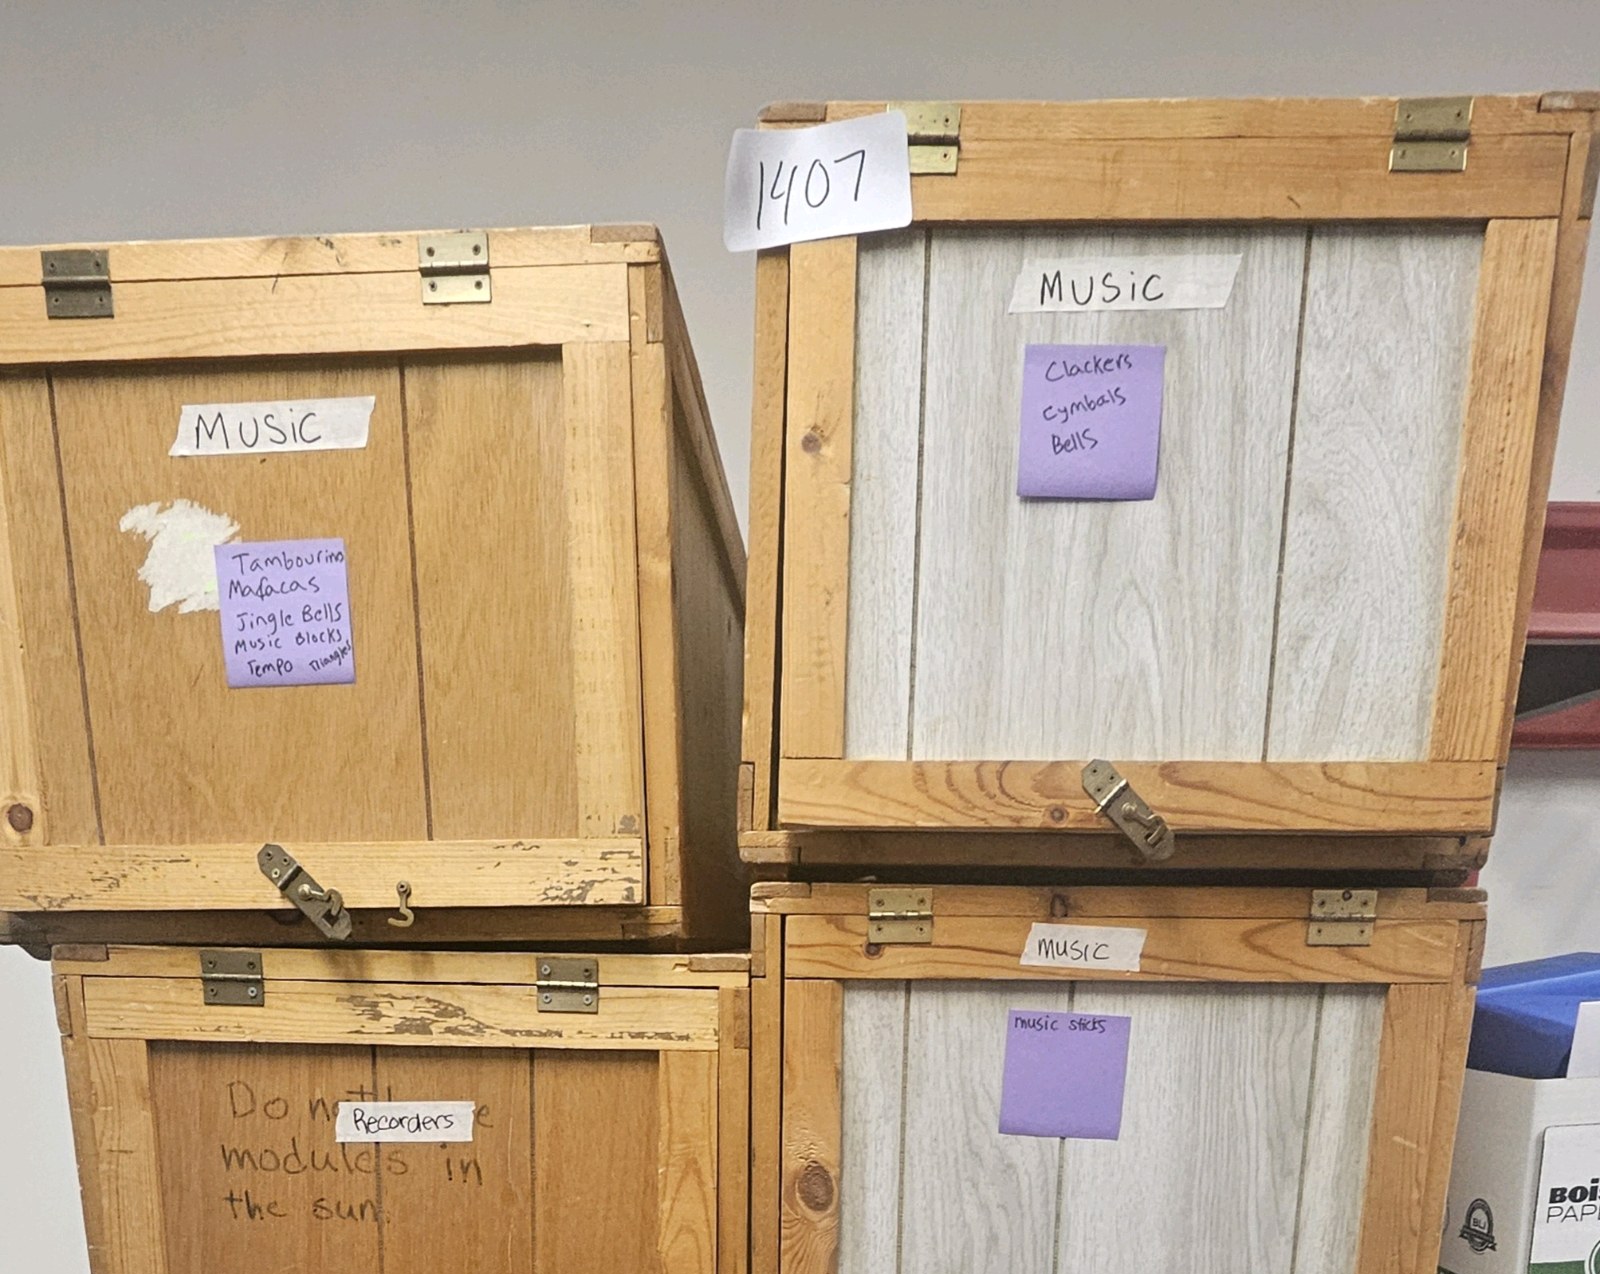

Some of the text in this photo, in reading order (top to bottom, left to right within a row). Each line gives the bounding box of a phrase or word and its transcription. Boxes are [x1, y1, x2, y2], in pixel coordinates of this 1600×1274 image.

[756, 149, 867, 231] 1407
[1045, 353, 1133, 382] Clackers
[1051, 428, 1099, 455] Bells
[236, 602, 342, 636] Jingle Bells
[1014, 1014, 1060, 1032] music
[227, 1080, 289, 1120] Do
[353, 1107, 455, 1134] Recorders
[220, 1137, 483, 1186] modules in
[224, 1189, 288, 1220] the
[1546, 1204, 1600, 1223] PAP
